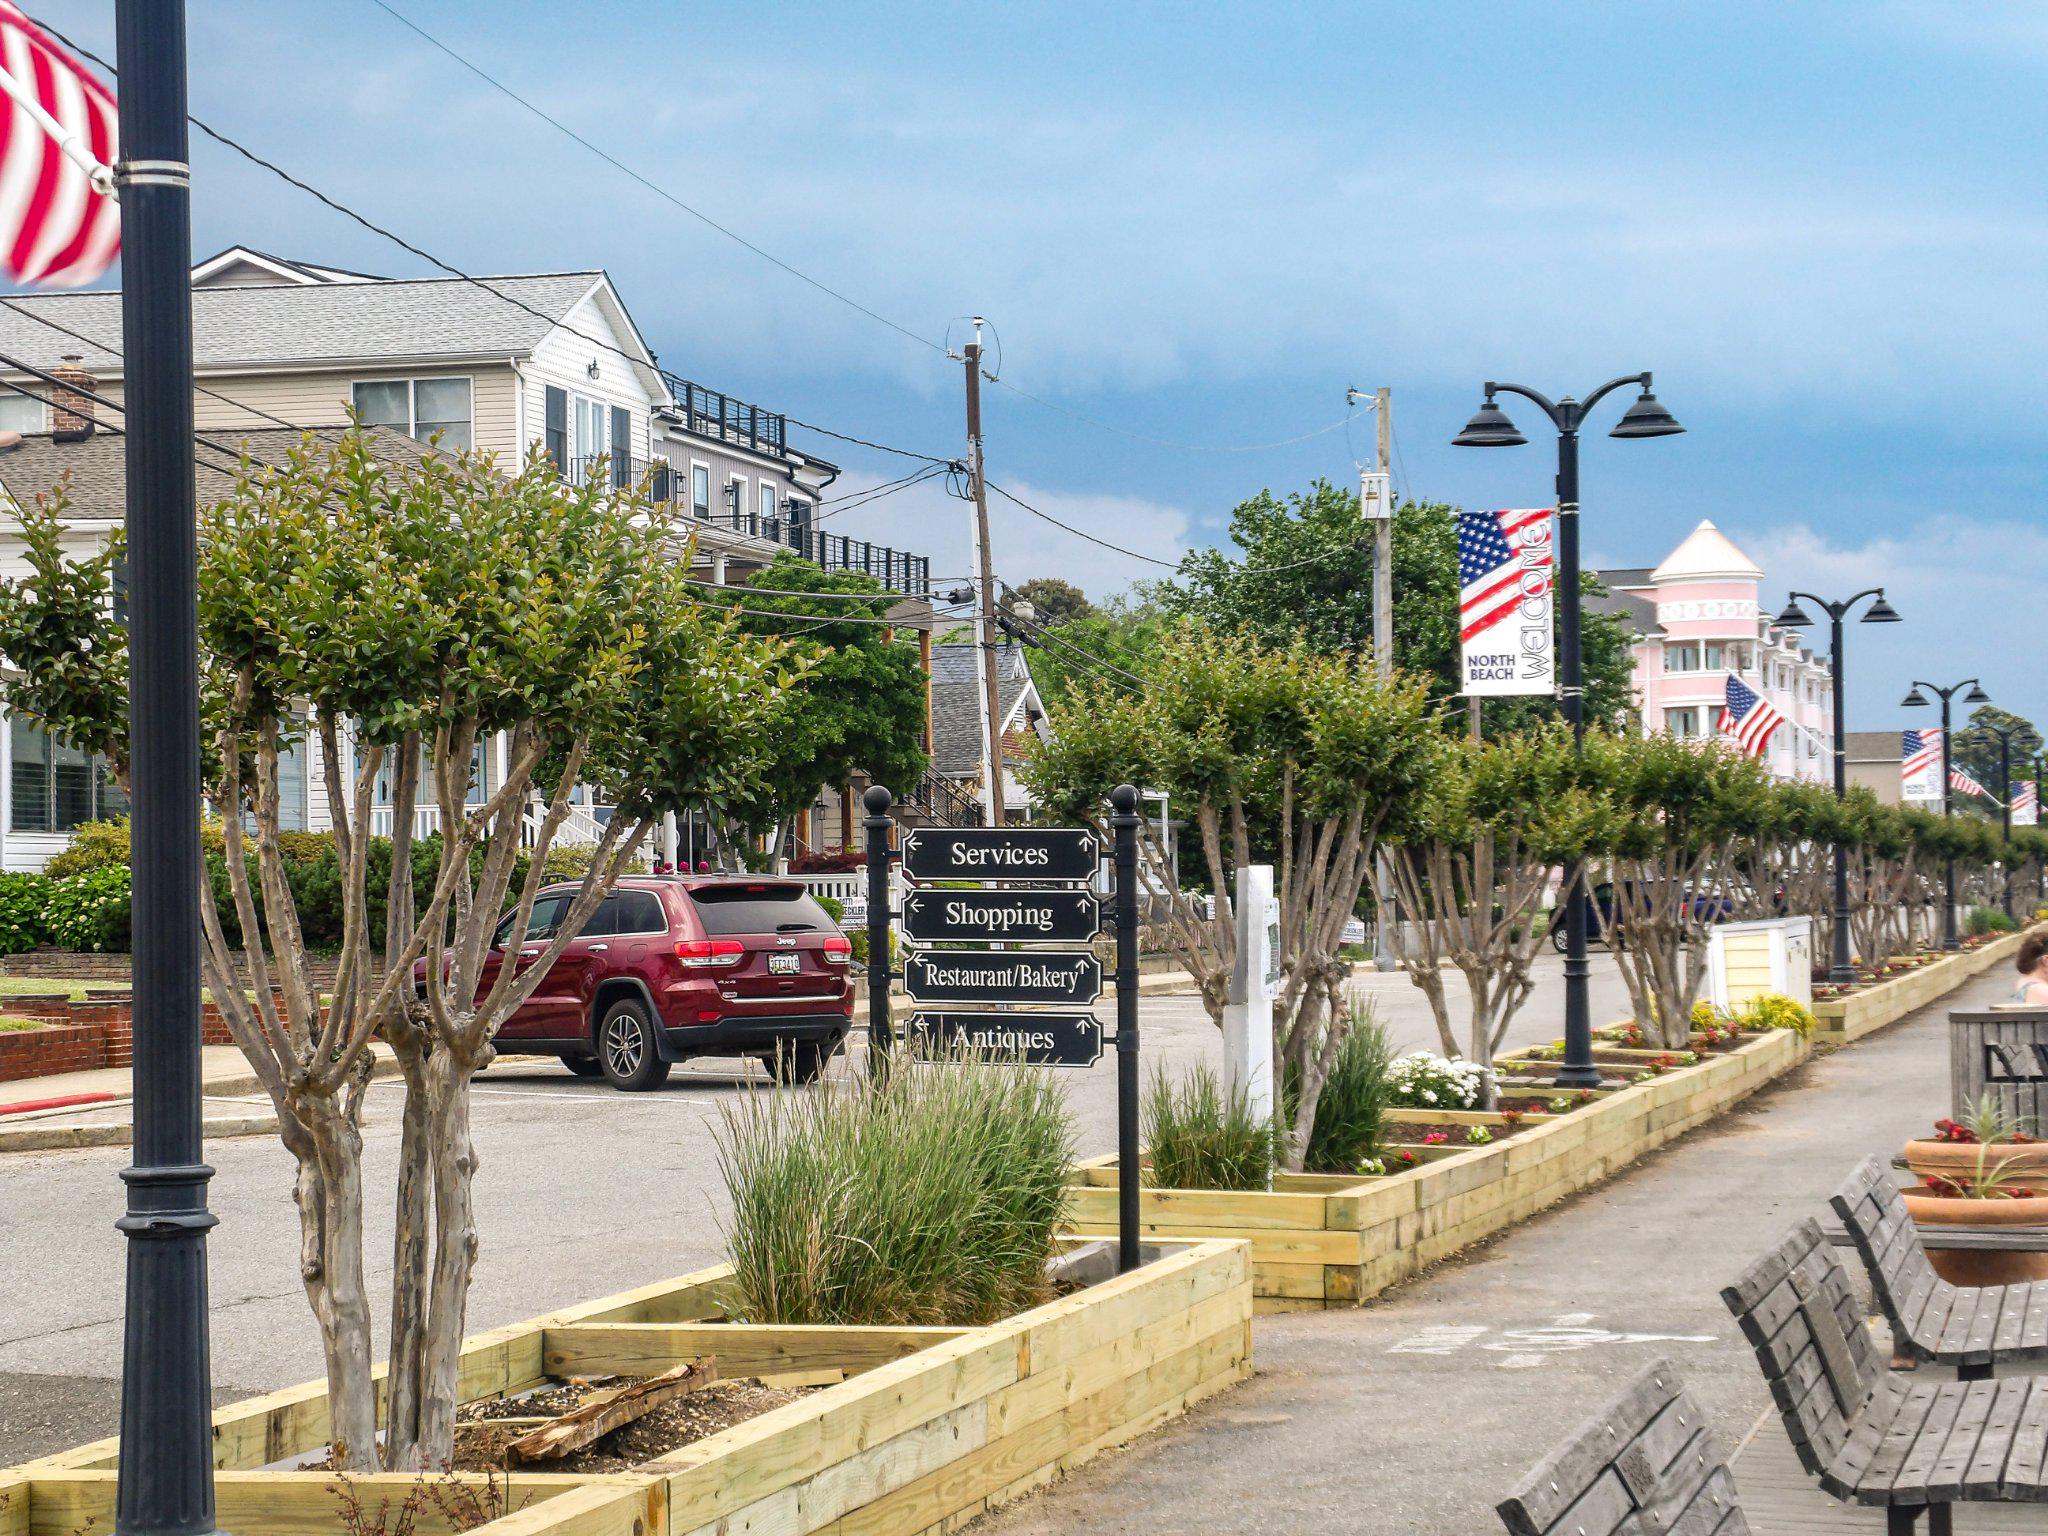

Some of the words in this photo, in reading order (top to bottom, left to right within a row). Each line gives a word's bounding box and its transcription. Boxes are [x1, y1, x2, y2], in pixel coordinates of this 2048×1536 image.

[1519, 523, 1550, 679] WELCOME
[1468, 654, 1516, 667] NORTH
[1470, 668, 1514, 681] BEACH
[951, 841, 1049, 865] Services
[946, 901, 1054, 931] Shopping
[776, 937, 796, 946] Jeep
[926, 963, 1079, 993] Restaurant/Bakery
[951, 1025, 1055, 1055] Antiques
